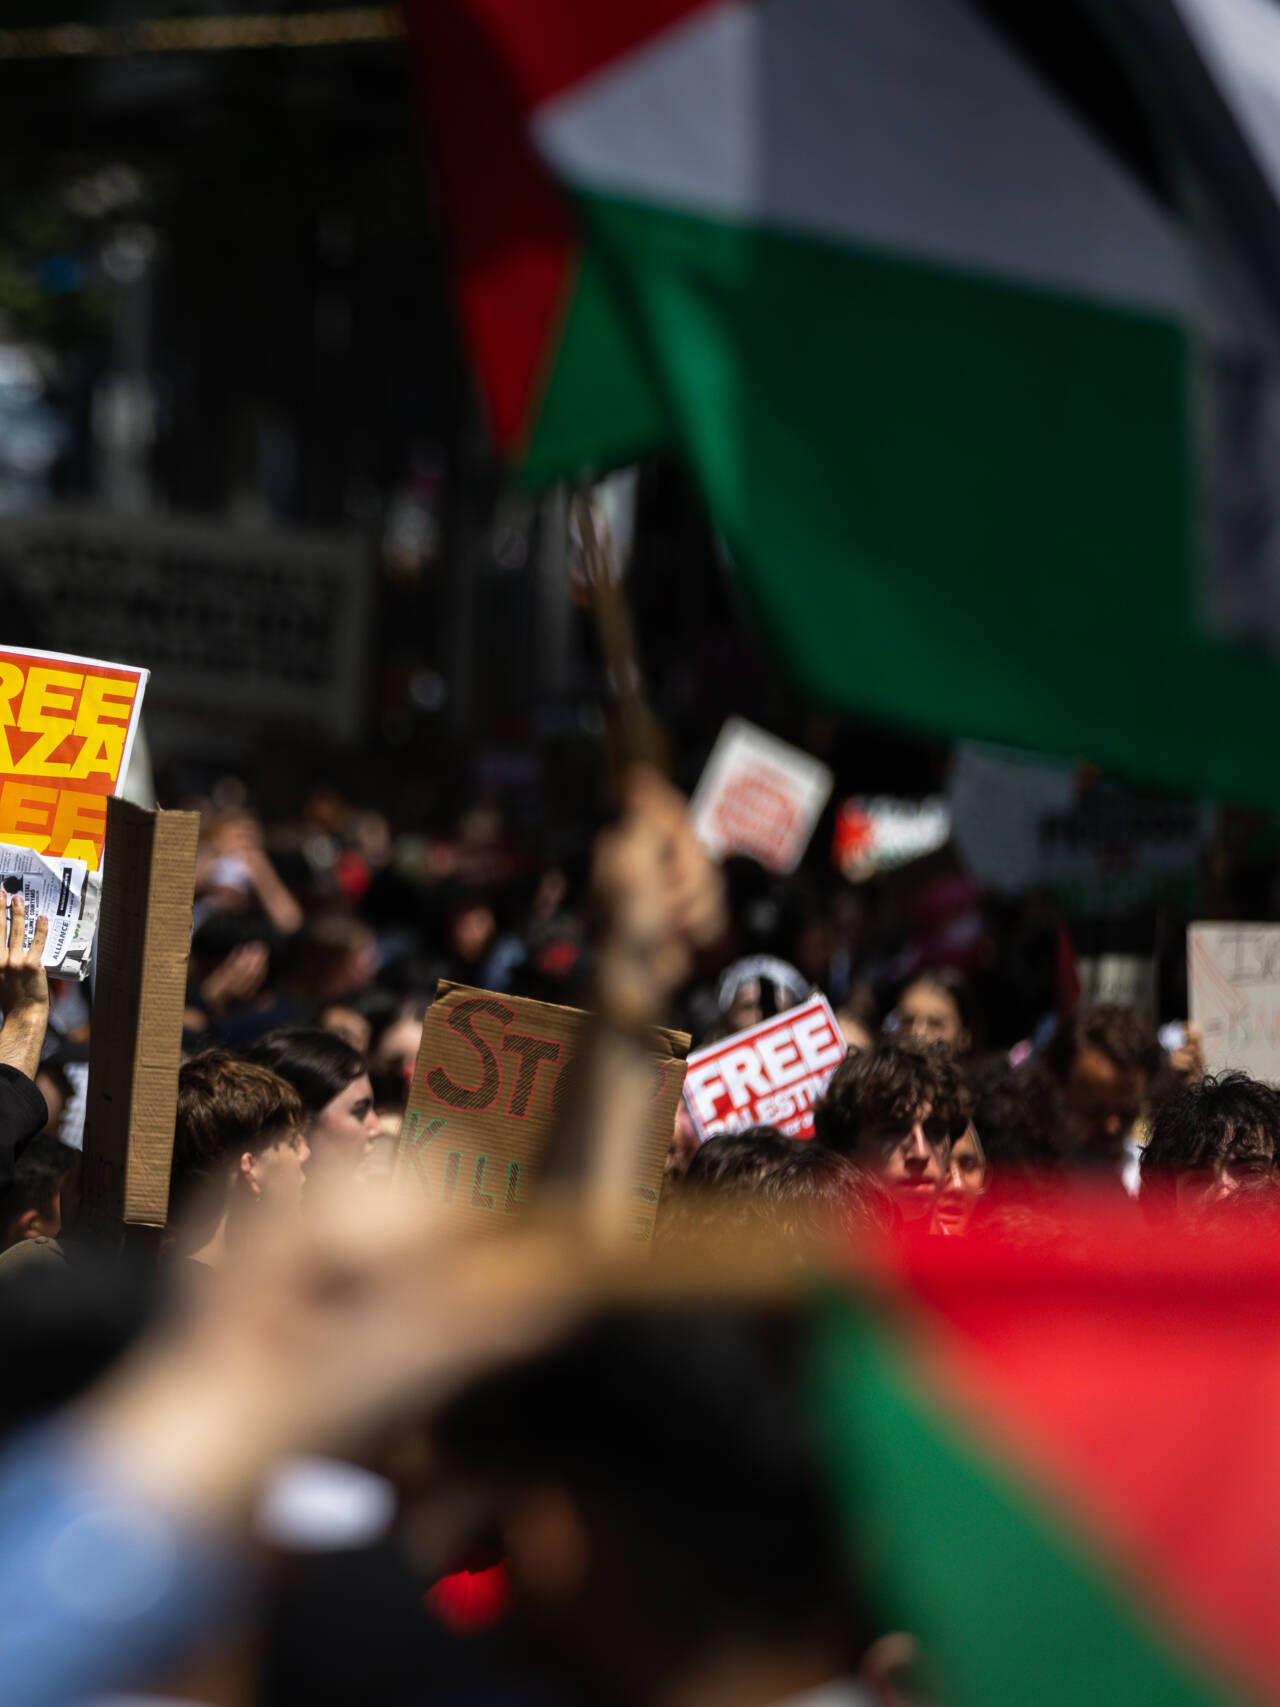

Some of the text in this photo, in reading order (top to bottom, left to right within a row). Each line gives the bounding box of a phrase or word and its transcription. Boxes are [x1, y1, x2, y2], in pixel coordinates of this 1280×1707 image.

[53, 921, 69, 960] ALLIANCE
[424, 997, 669, 1120] ST
[686, 1011, 843, 1122] FREE
[705, 1066, 839, 1137] PALESTIN
